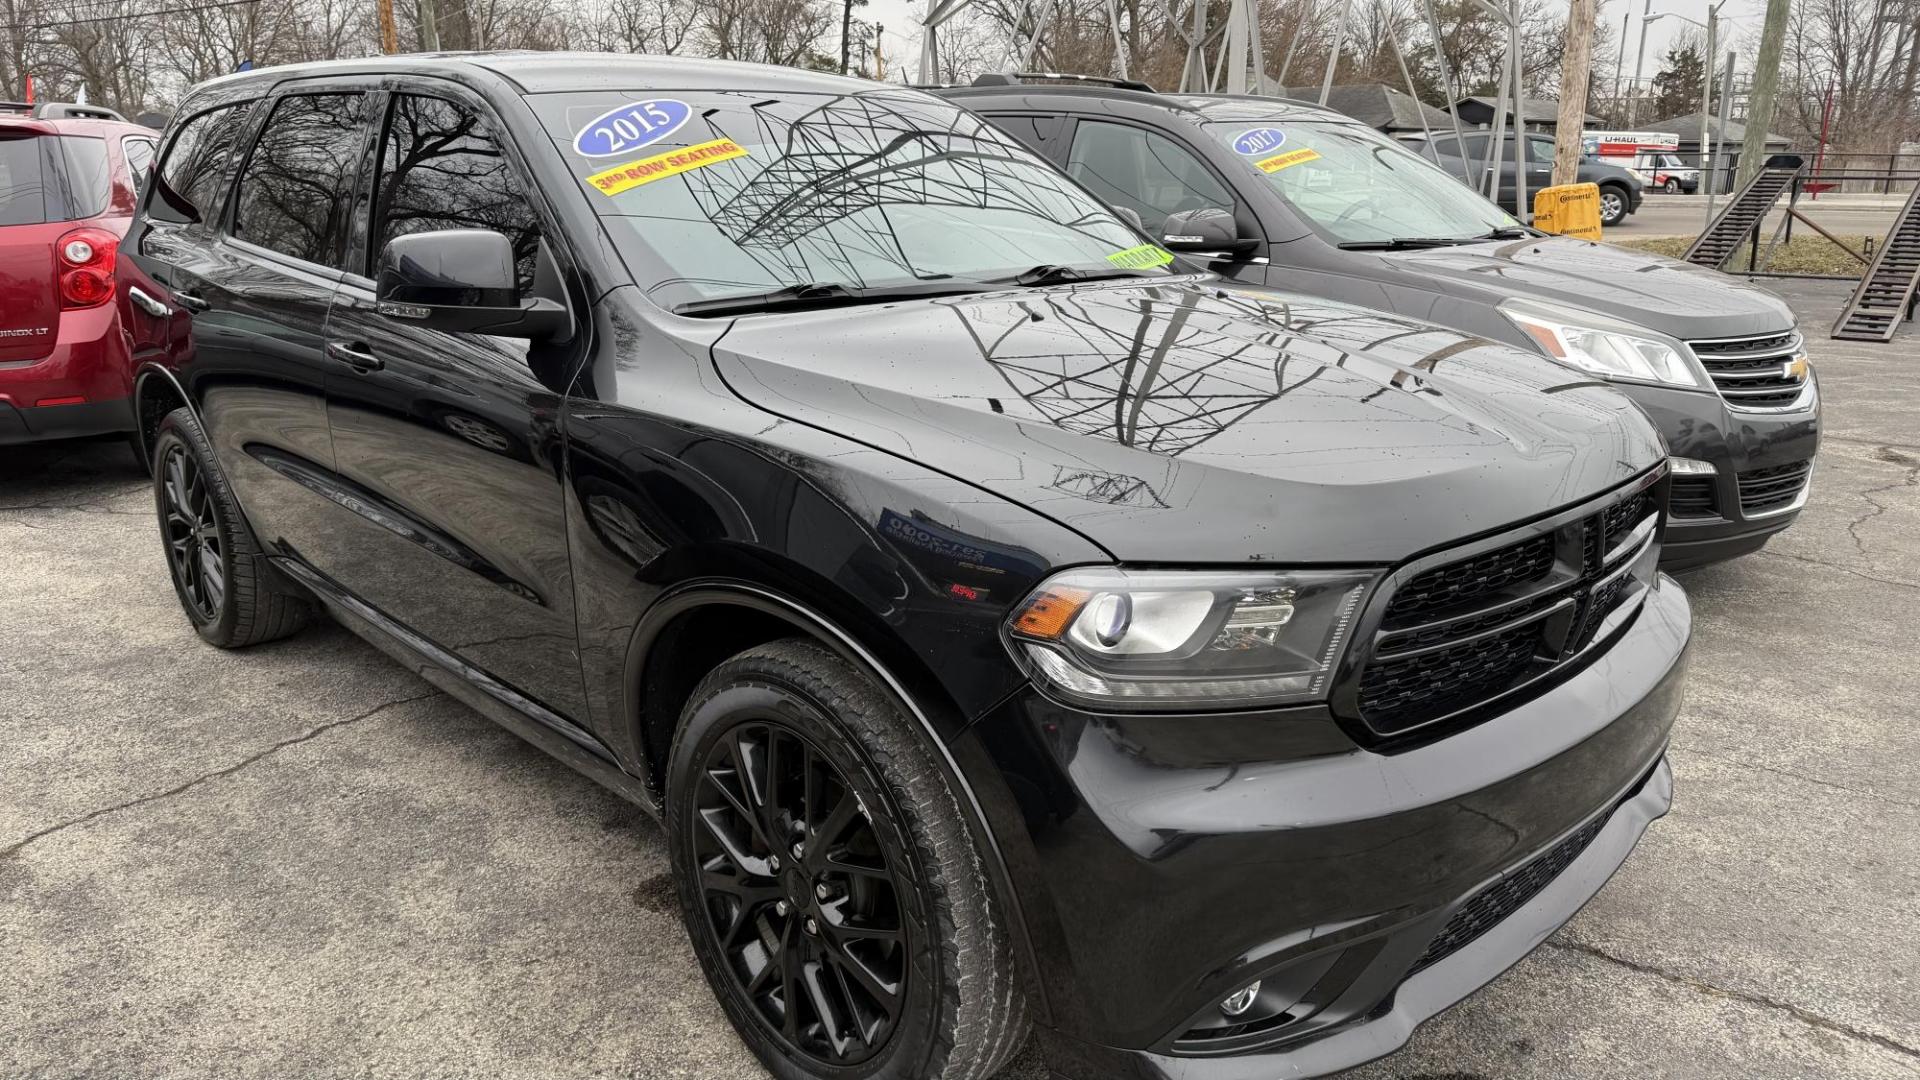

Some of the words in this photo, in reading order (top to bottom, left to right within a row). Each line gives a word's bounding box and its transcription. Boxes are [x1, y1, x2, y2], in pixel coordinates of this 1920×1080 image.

[594, 102, 671, 152] 2015
[1240, 129, 1276, 154] 2017
[595, 173, 624, 190] 3RD
[624, 160, 667, 180] ROW
[667, 142, 737, 166] SEATING
[36, 327, 49, 335] LT
